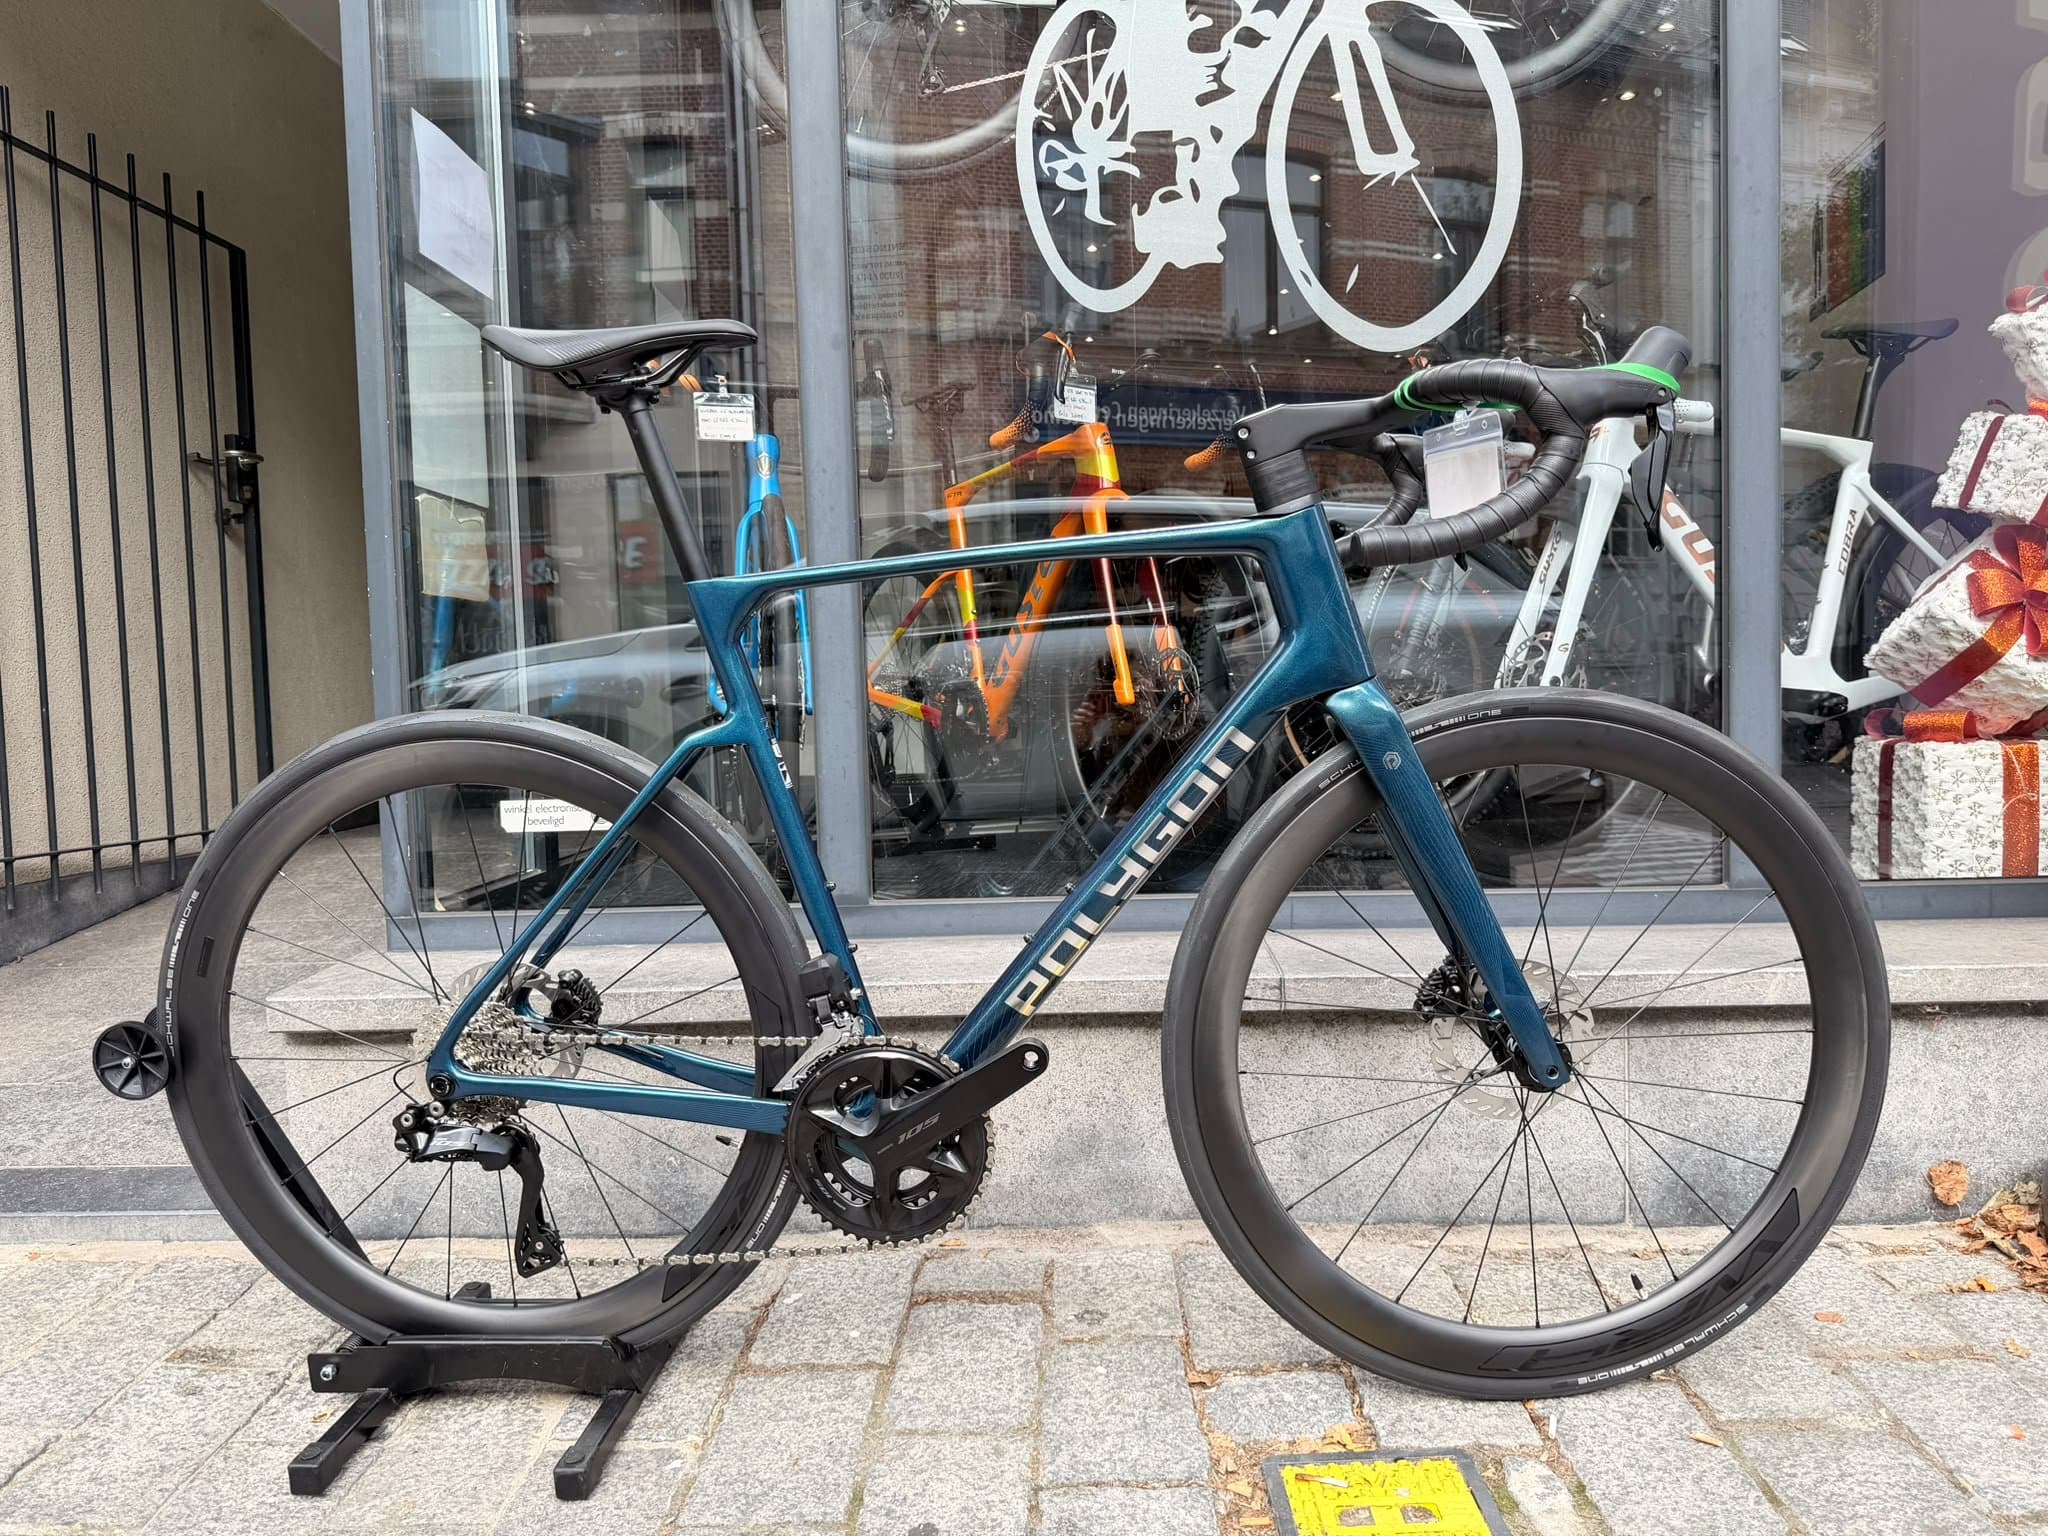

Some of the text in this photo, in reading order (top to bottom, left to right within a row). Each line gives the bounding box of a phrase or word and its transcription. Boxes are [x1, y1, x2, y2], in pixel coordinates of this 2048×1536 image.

[1538, 530, 1562, 585] GUSTO
[1837, 509, 1857, 576] COBRA
[1467, 709, 1502, 720] ONE
[504, 804, 532, 814] winkel
[527, 816, 565, 827] beveiligd
[1004, 726, 1257, 1017] POLYGON
[182, 890, 200, 918] ONE
[897, 1112, 941, 1145] 105
[1577, 1303, 1749, 1385] SCHWALBE ONE
